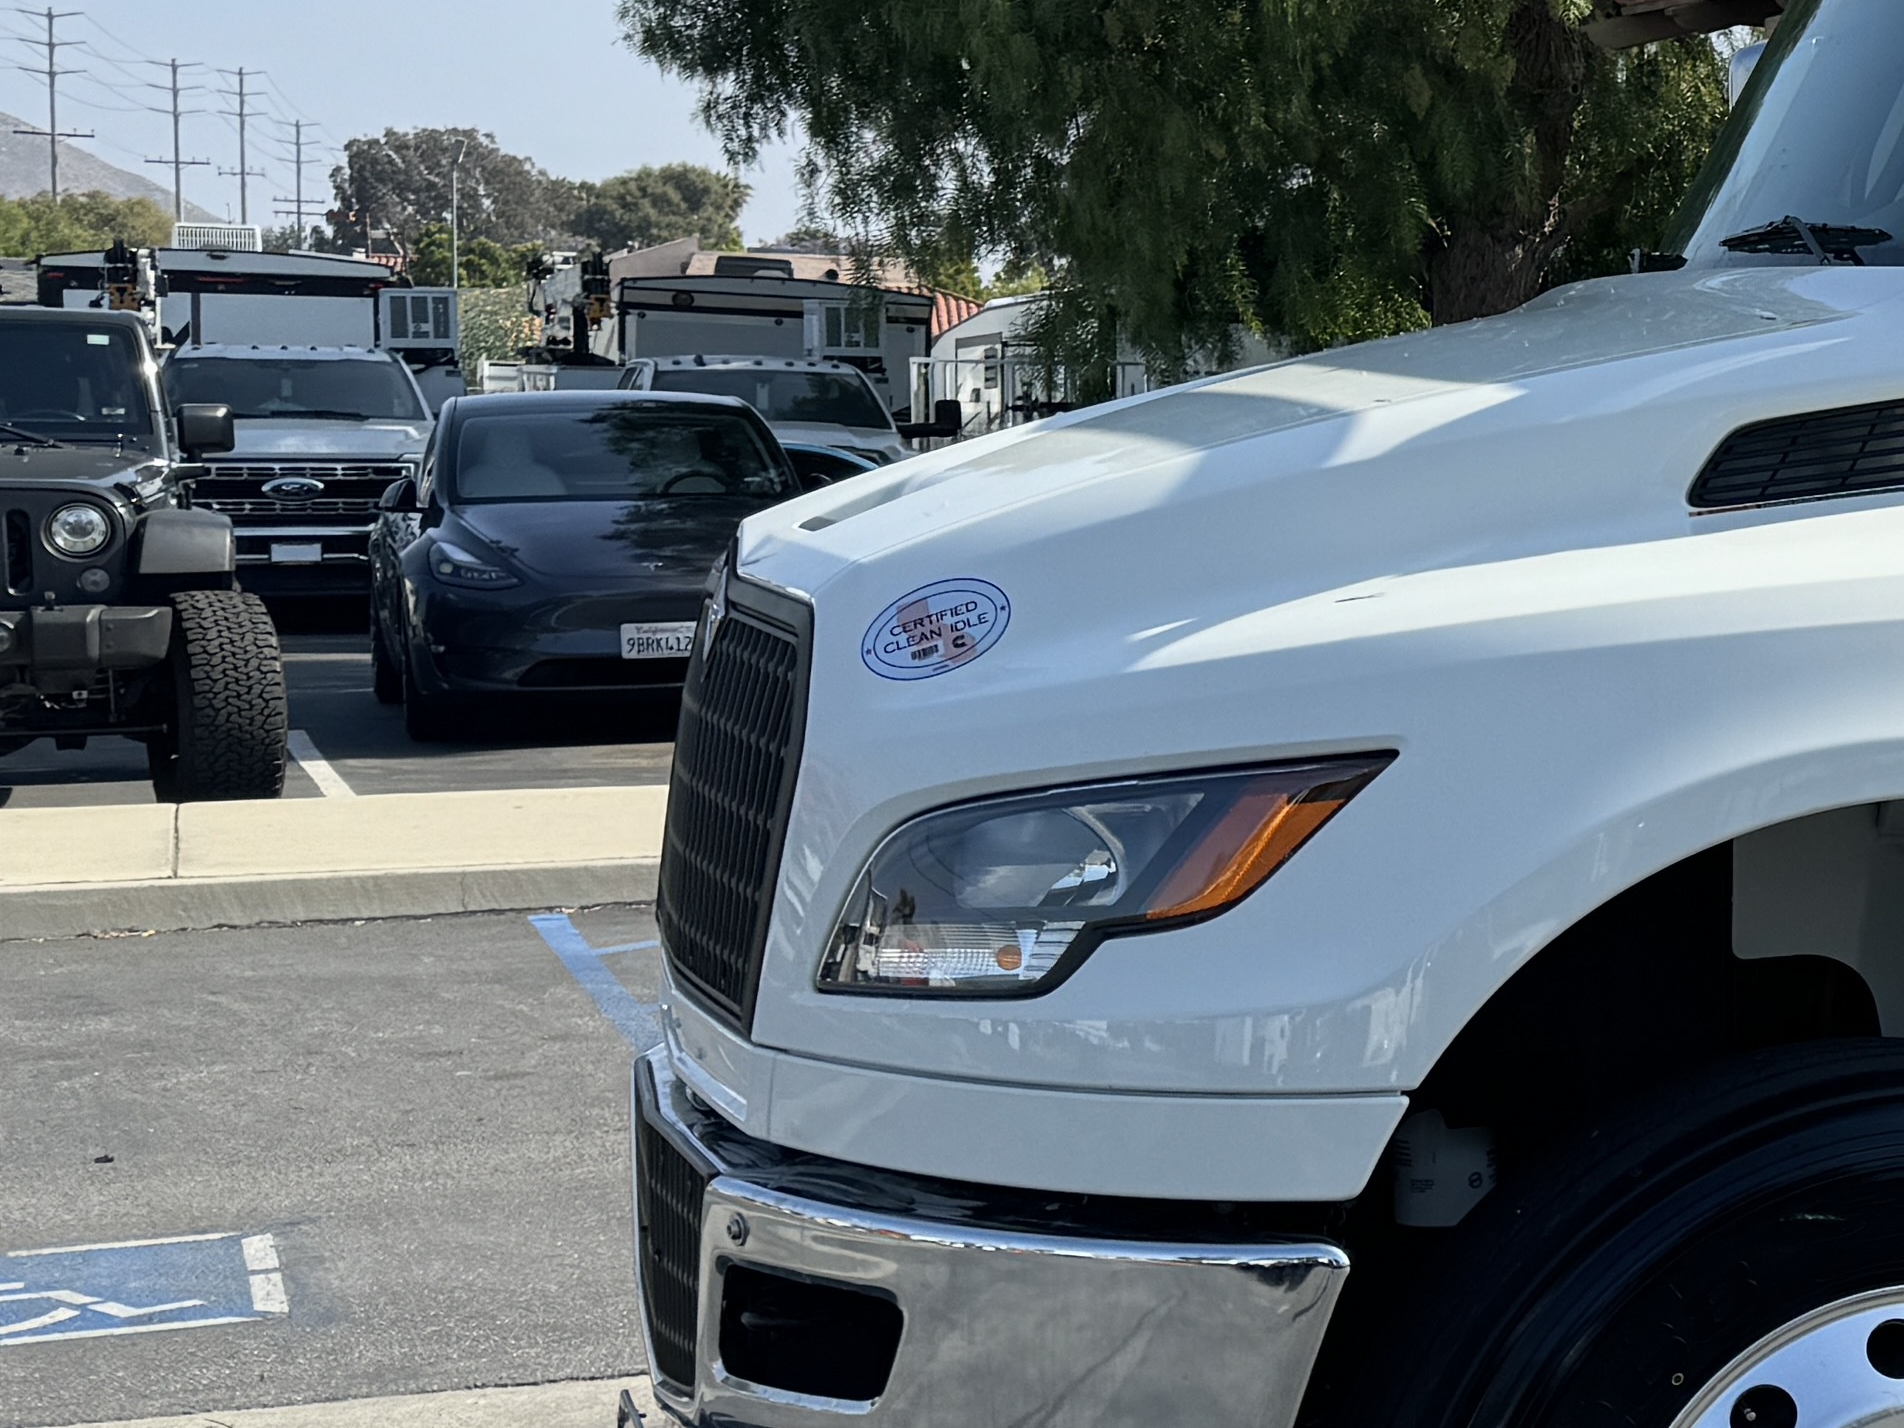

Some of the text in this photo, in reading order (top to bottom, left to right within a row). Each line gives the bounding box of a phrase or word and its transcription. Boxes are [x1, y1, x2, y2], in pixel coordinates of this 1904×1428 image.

[883, 612, 990, 655] CLEAN IDLE
[889, 600, 978, 638] CERTIFIED
